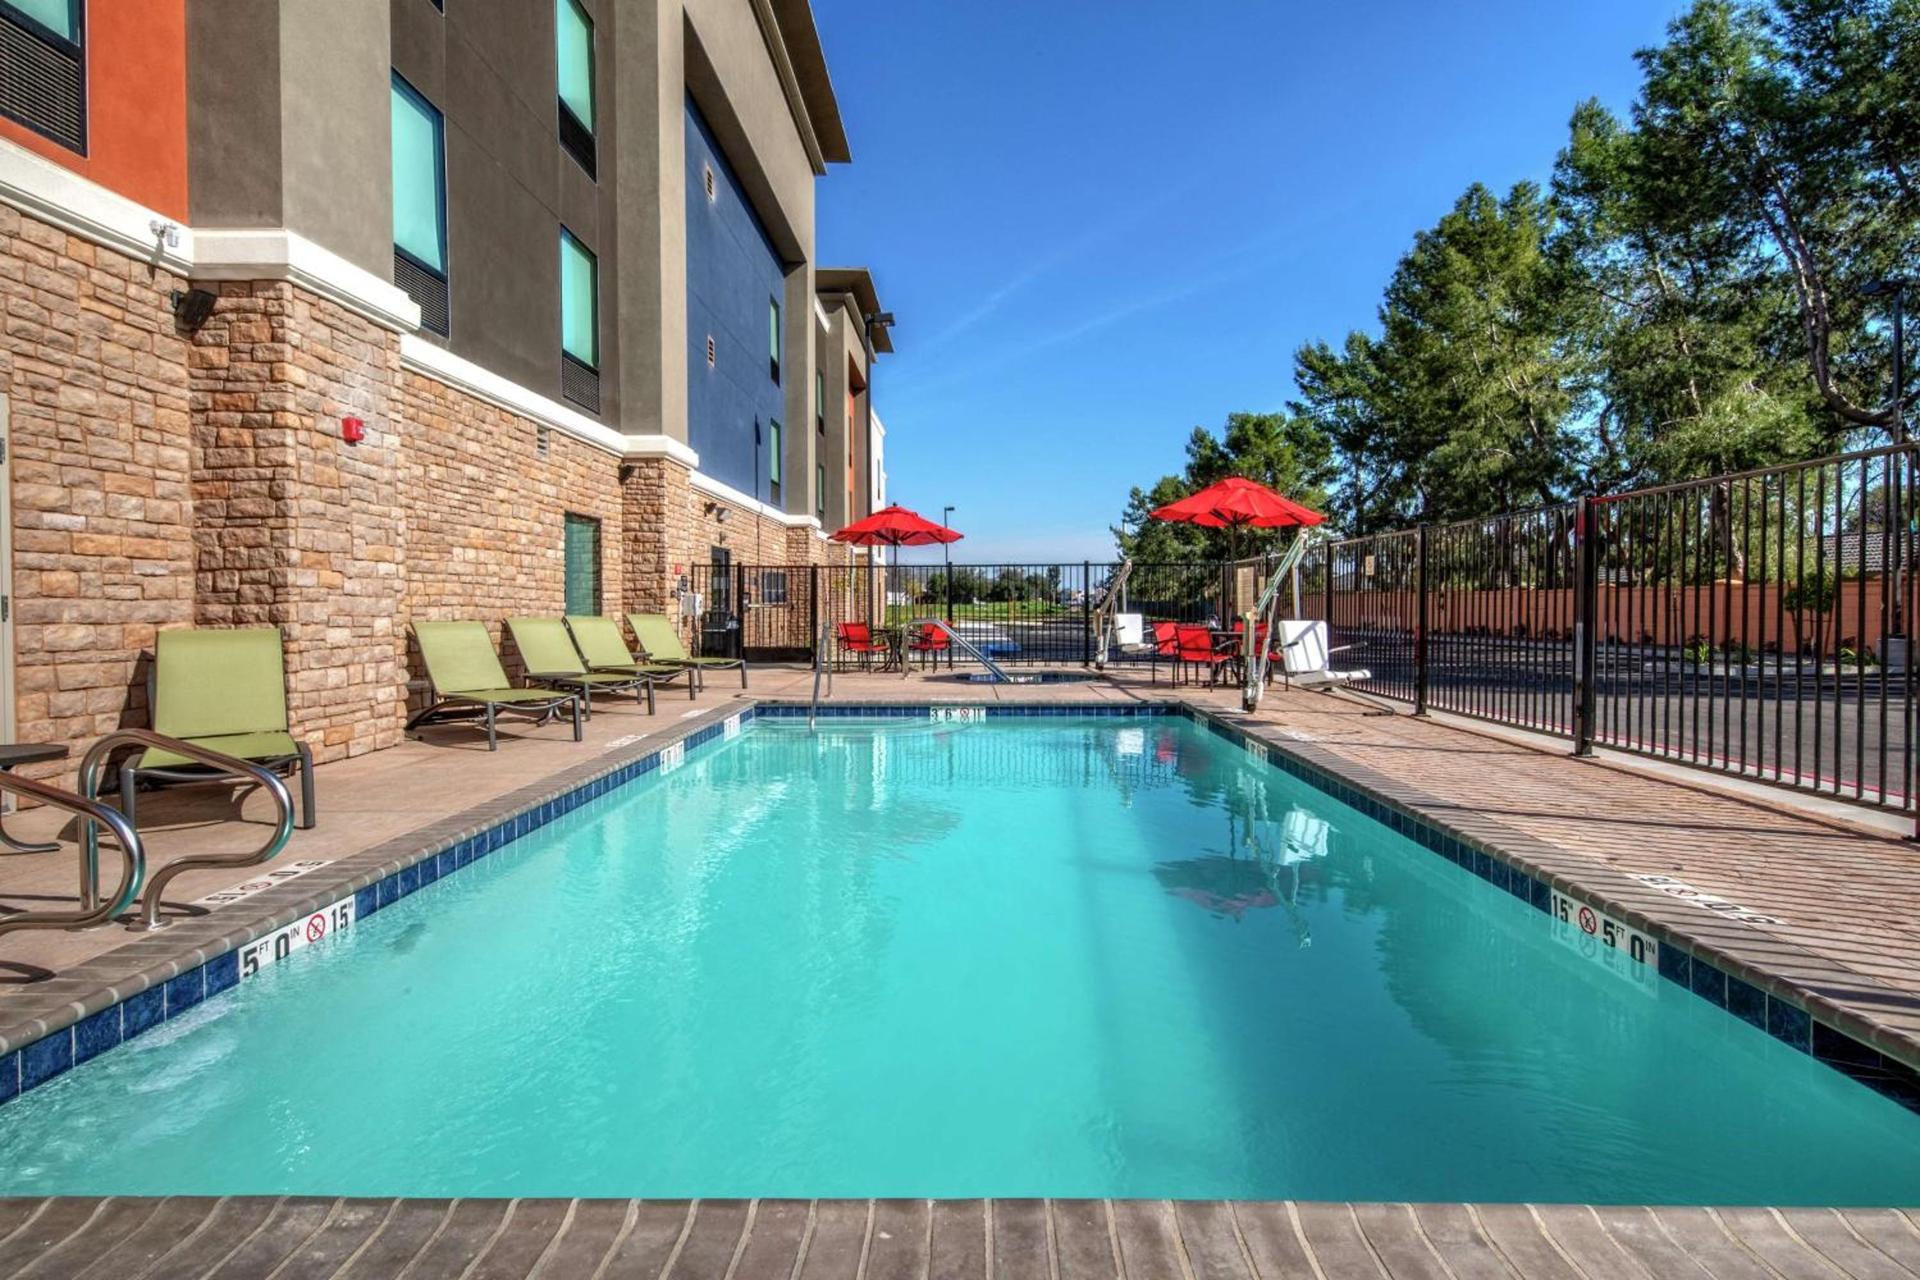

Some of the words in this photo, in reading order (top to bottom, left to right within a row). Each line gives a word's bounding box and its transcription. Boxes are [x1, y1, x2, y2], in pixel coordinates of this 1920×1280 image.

[243, 947, 259, 977] 5
[259, 941, 270, 956] FT
[275, 932, 290, 961] 0
[290, 925, 300, 939] IN
[1603, 920, 1617, 948] 5
[1616, 927, 1625, 939] FT
[1630, 934, 1645, 964] 0
[1645, 940, 1656, 955] IN
